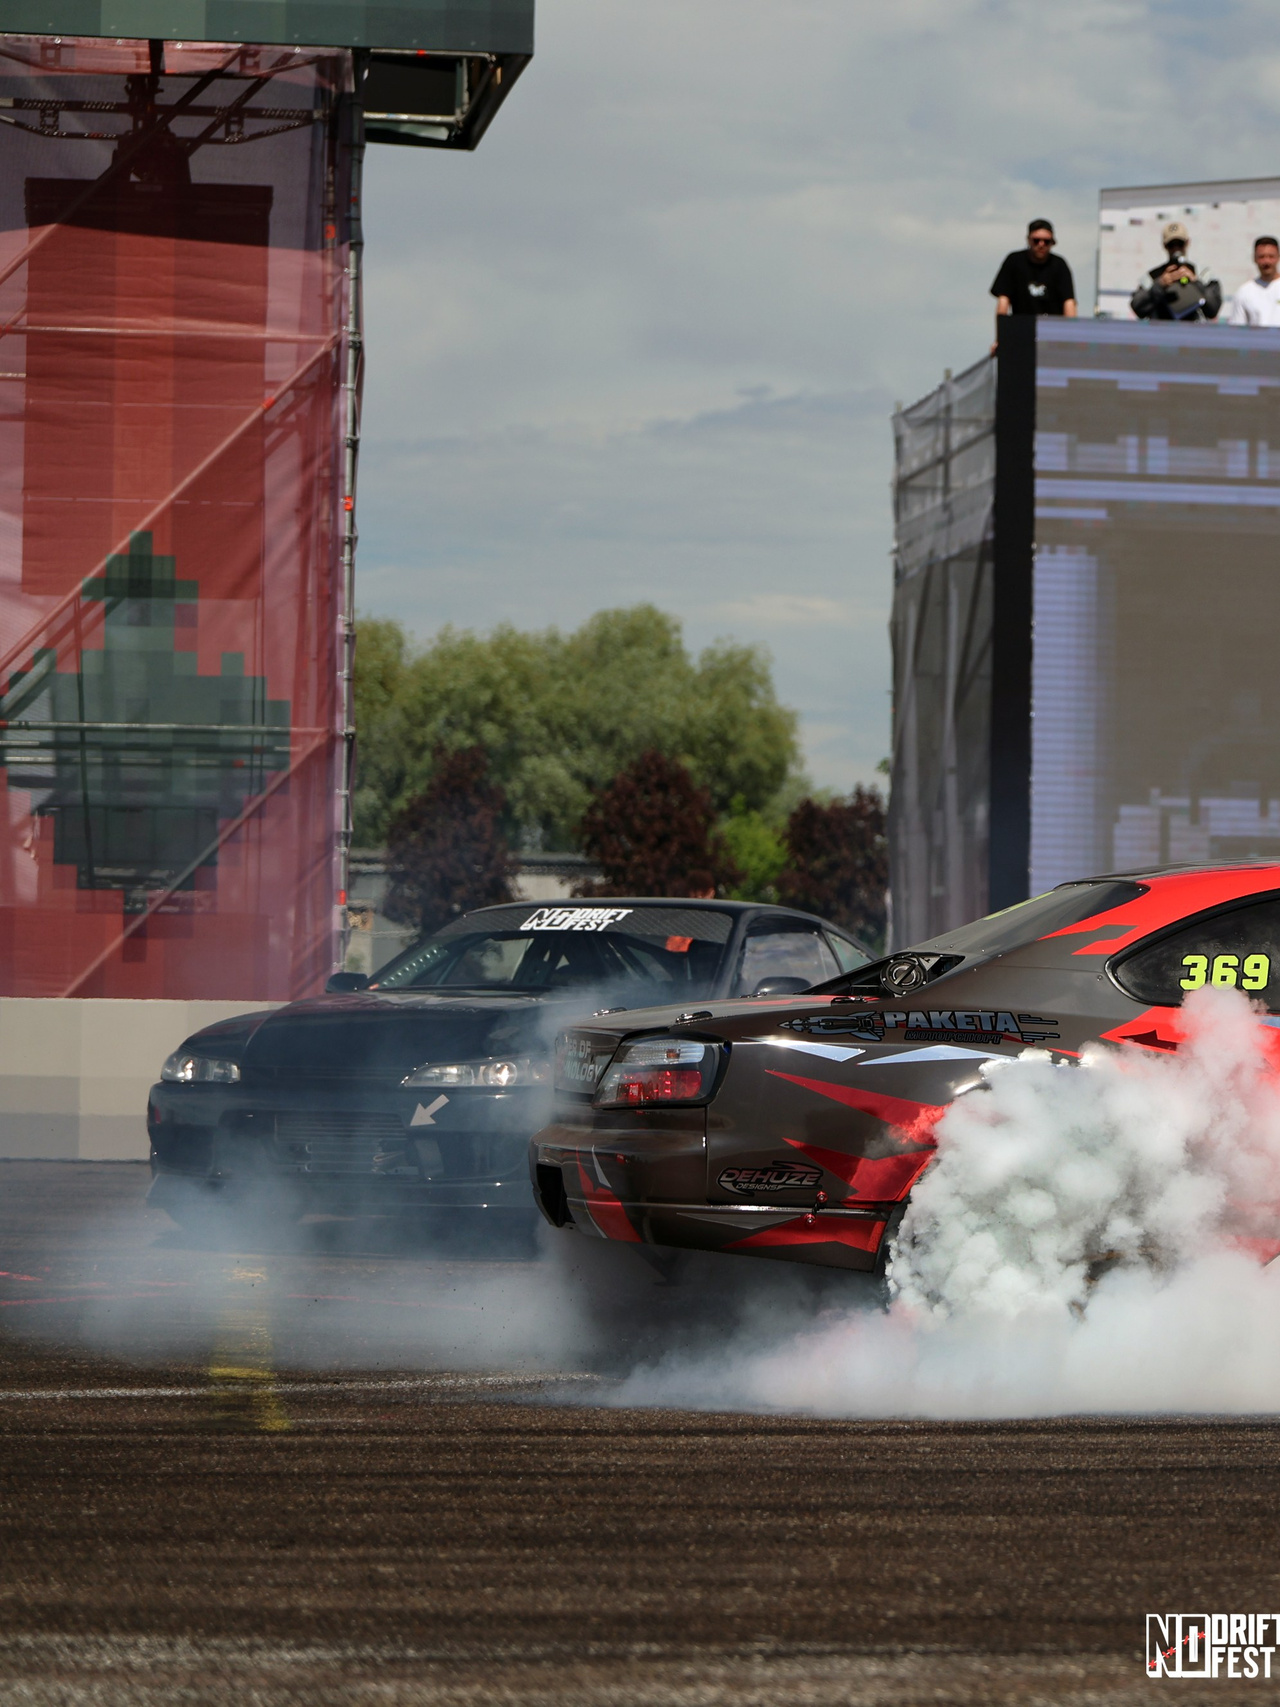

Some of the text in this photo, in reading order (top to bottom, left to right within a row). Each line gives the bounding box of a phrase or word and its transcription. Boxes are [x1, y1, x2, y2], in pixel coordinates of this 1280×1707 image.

[572, 908, 634, 921] DRIFT
[562, 919, 615, 931] FEST
[1179, 953, 1270, 990] 369
[720, 1168, 821, 1186] DEHUZE
[735, 1182, 780, 1191] DESIGNS
